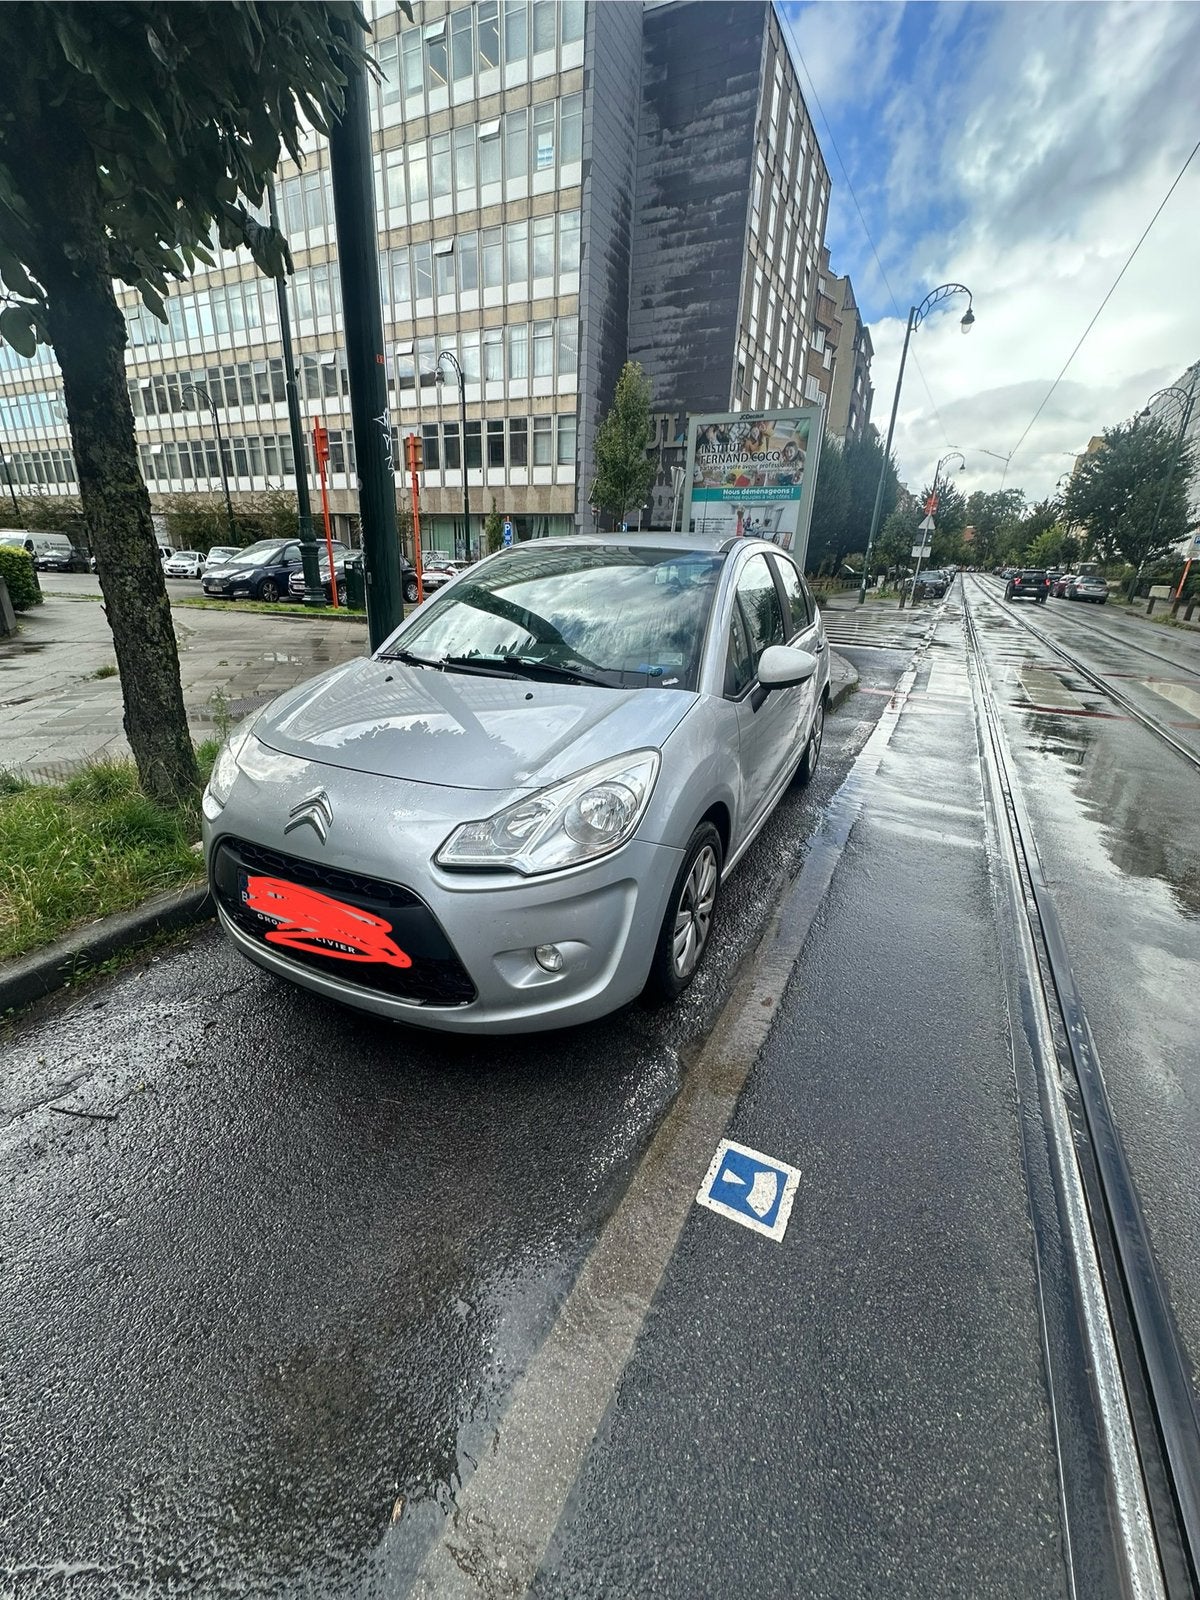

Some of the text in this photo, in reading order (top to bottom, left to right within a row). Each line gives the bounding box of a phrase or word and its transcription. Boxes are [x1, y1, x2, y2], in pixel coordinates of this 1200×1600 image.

[739, 413, 764, 421] JCDecaux
[701, 443, 742, 454] INSTITUT
[700, 451, 781, 465] FERNAND COCQ
[741, 487, 790, 496] déménageons
[257, 913, 283, 926] GRO
[311, 936, 356, 954] LIVIER
